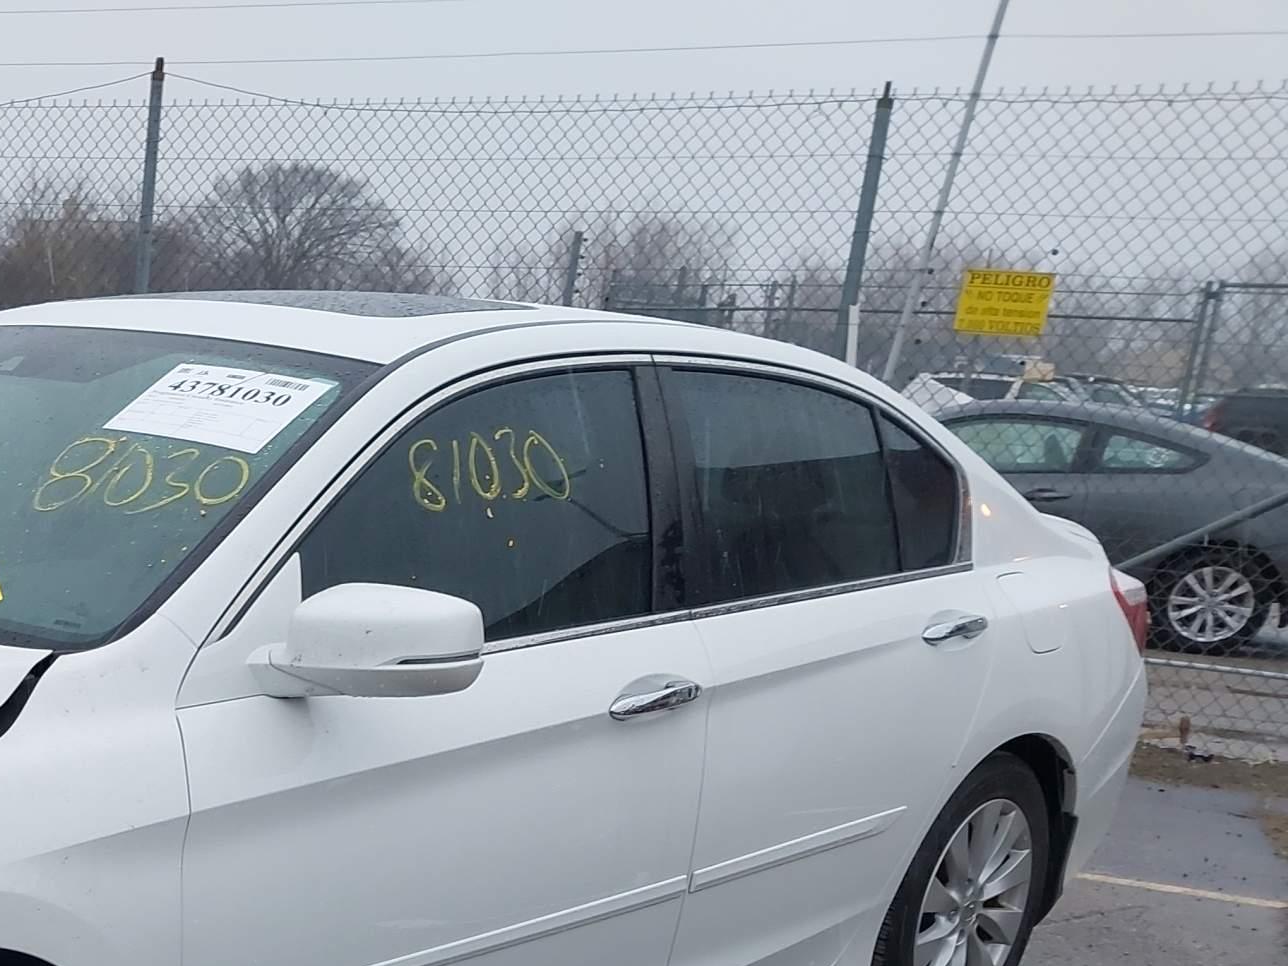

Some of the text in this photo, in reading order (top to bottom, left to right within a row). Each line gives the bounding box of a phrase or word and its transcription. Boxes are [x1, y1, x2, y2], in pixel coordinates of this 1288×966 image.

[969, 272, 1050, 289] PELIGRO
[977, 290, 1035, 304] NO TOQUE
[168, 379, 292, 406] 43781030
[33, 437, 249, 512] 81030
[409, 427, 571, 511] 81030
